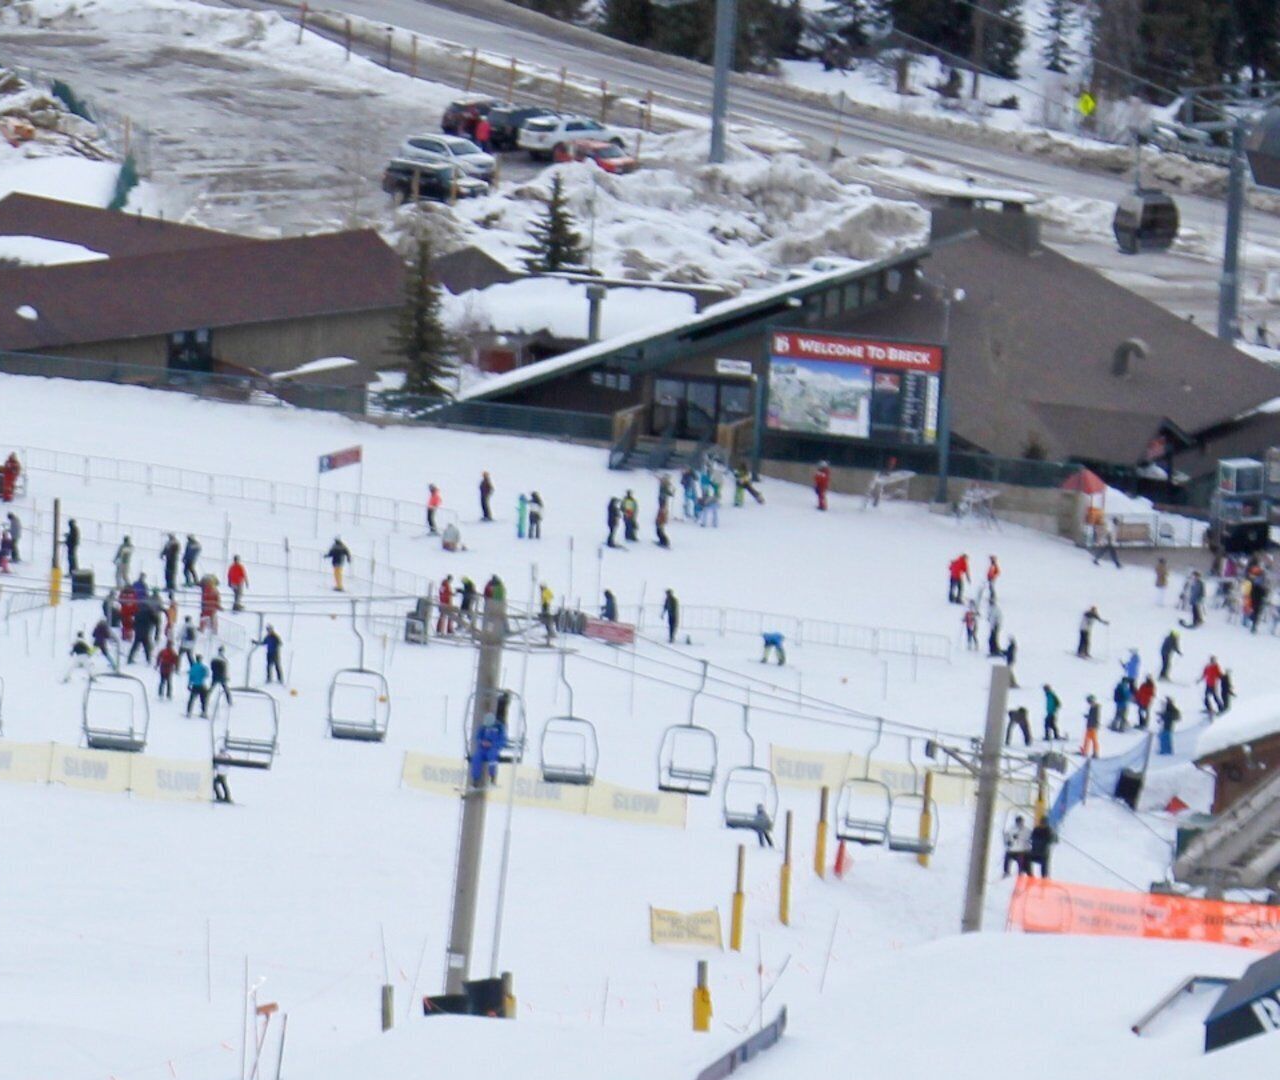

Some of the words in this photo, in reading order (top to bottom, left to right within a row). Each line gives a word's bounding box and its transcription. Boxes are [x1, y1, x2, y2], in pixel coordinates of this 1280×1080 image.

[798, 338, 865, 359] WELCOME
[866, 345, 886, 360] TO
[887, 347, 931, 365] BRECK
[63, 756, 109, 780] SLOW
[776, 758, 824, 781] SLOW
[156, 769, 201, 791] SLOW
[612, 792, 660, 815] SLOW
